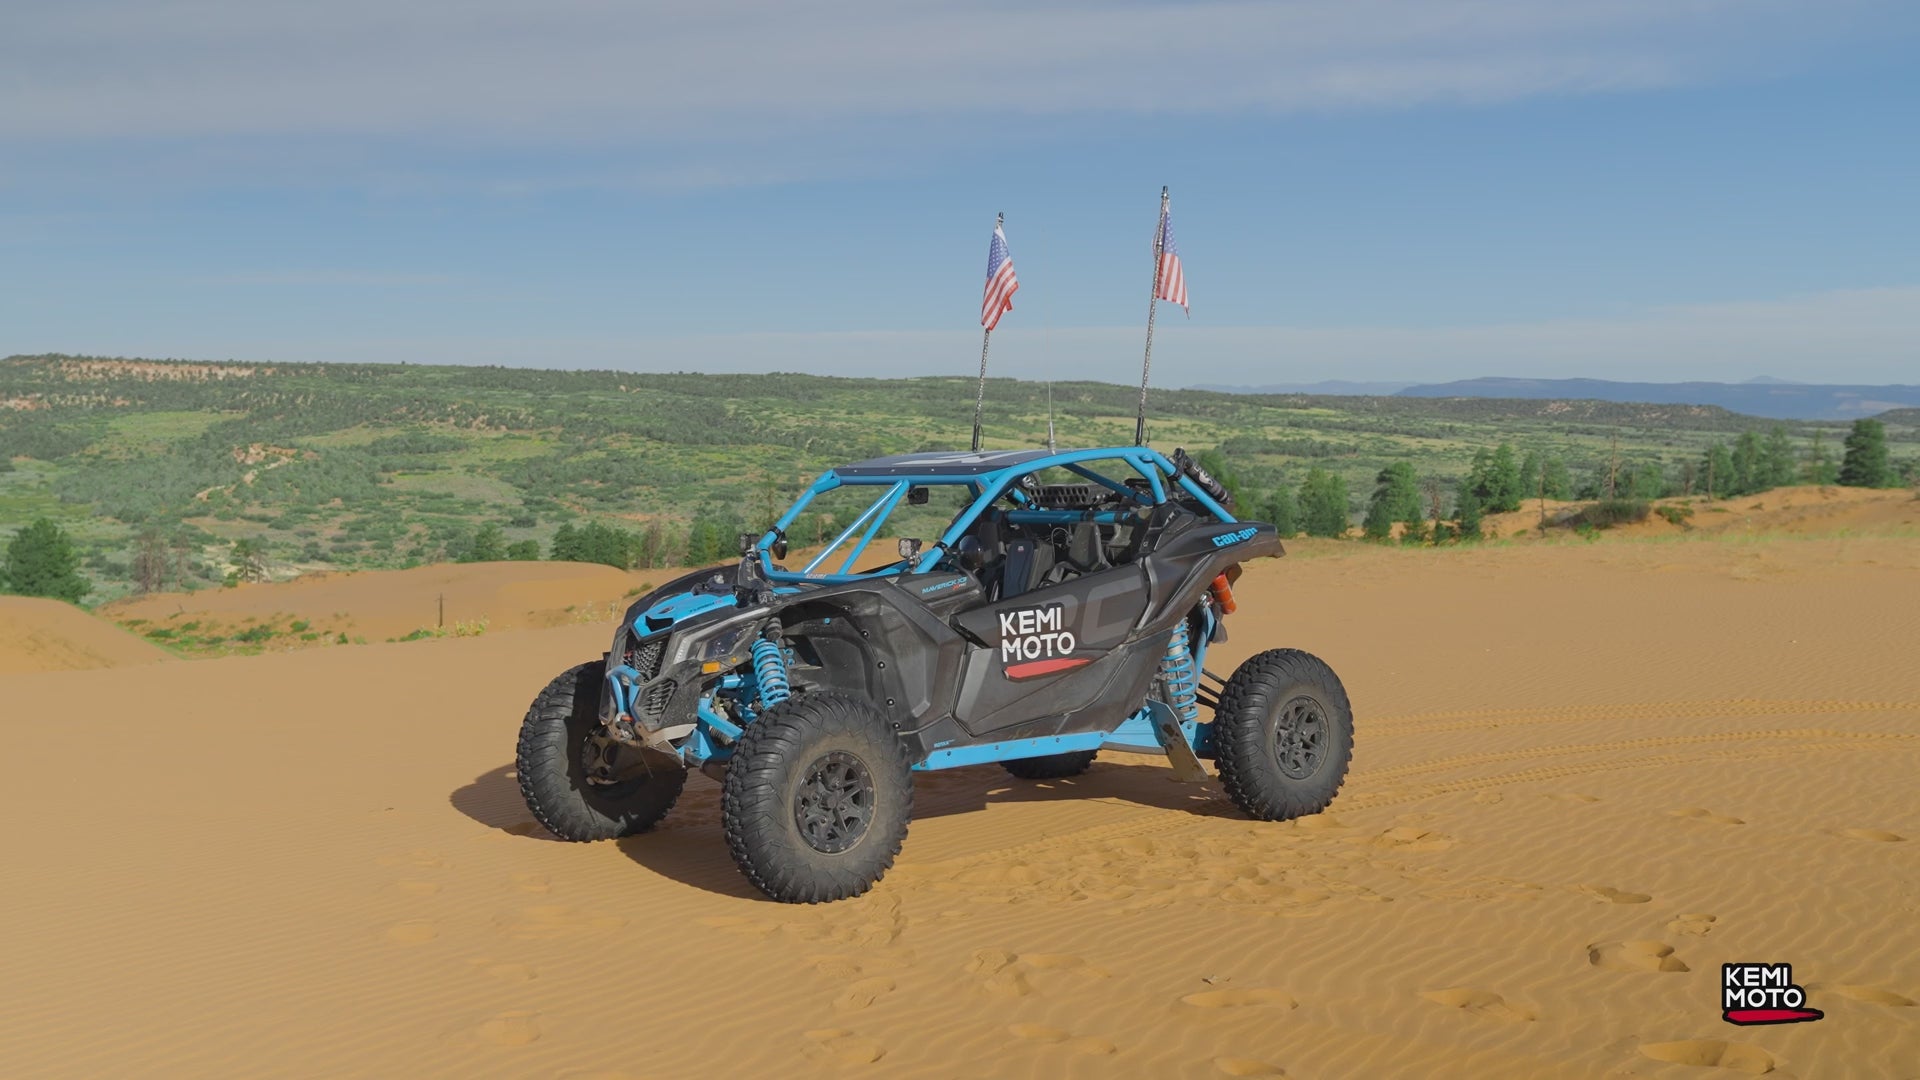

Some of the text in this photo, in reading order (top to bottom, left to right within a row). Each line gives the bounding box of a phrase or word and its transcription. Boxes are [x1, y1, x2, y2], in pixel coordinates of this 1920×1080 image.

[922, 580, 956, 593] MAVERICK
[1000, 607, 1062, 636] KEMI
[1002, 632, 1076, 662] MOTO
